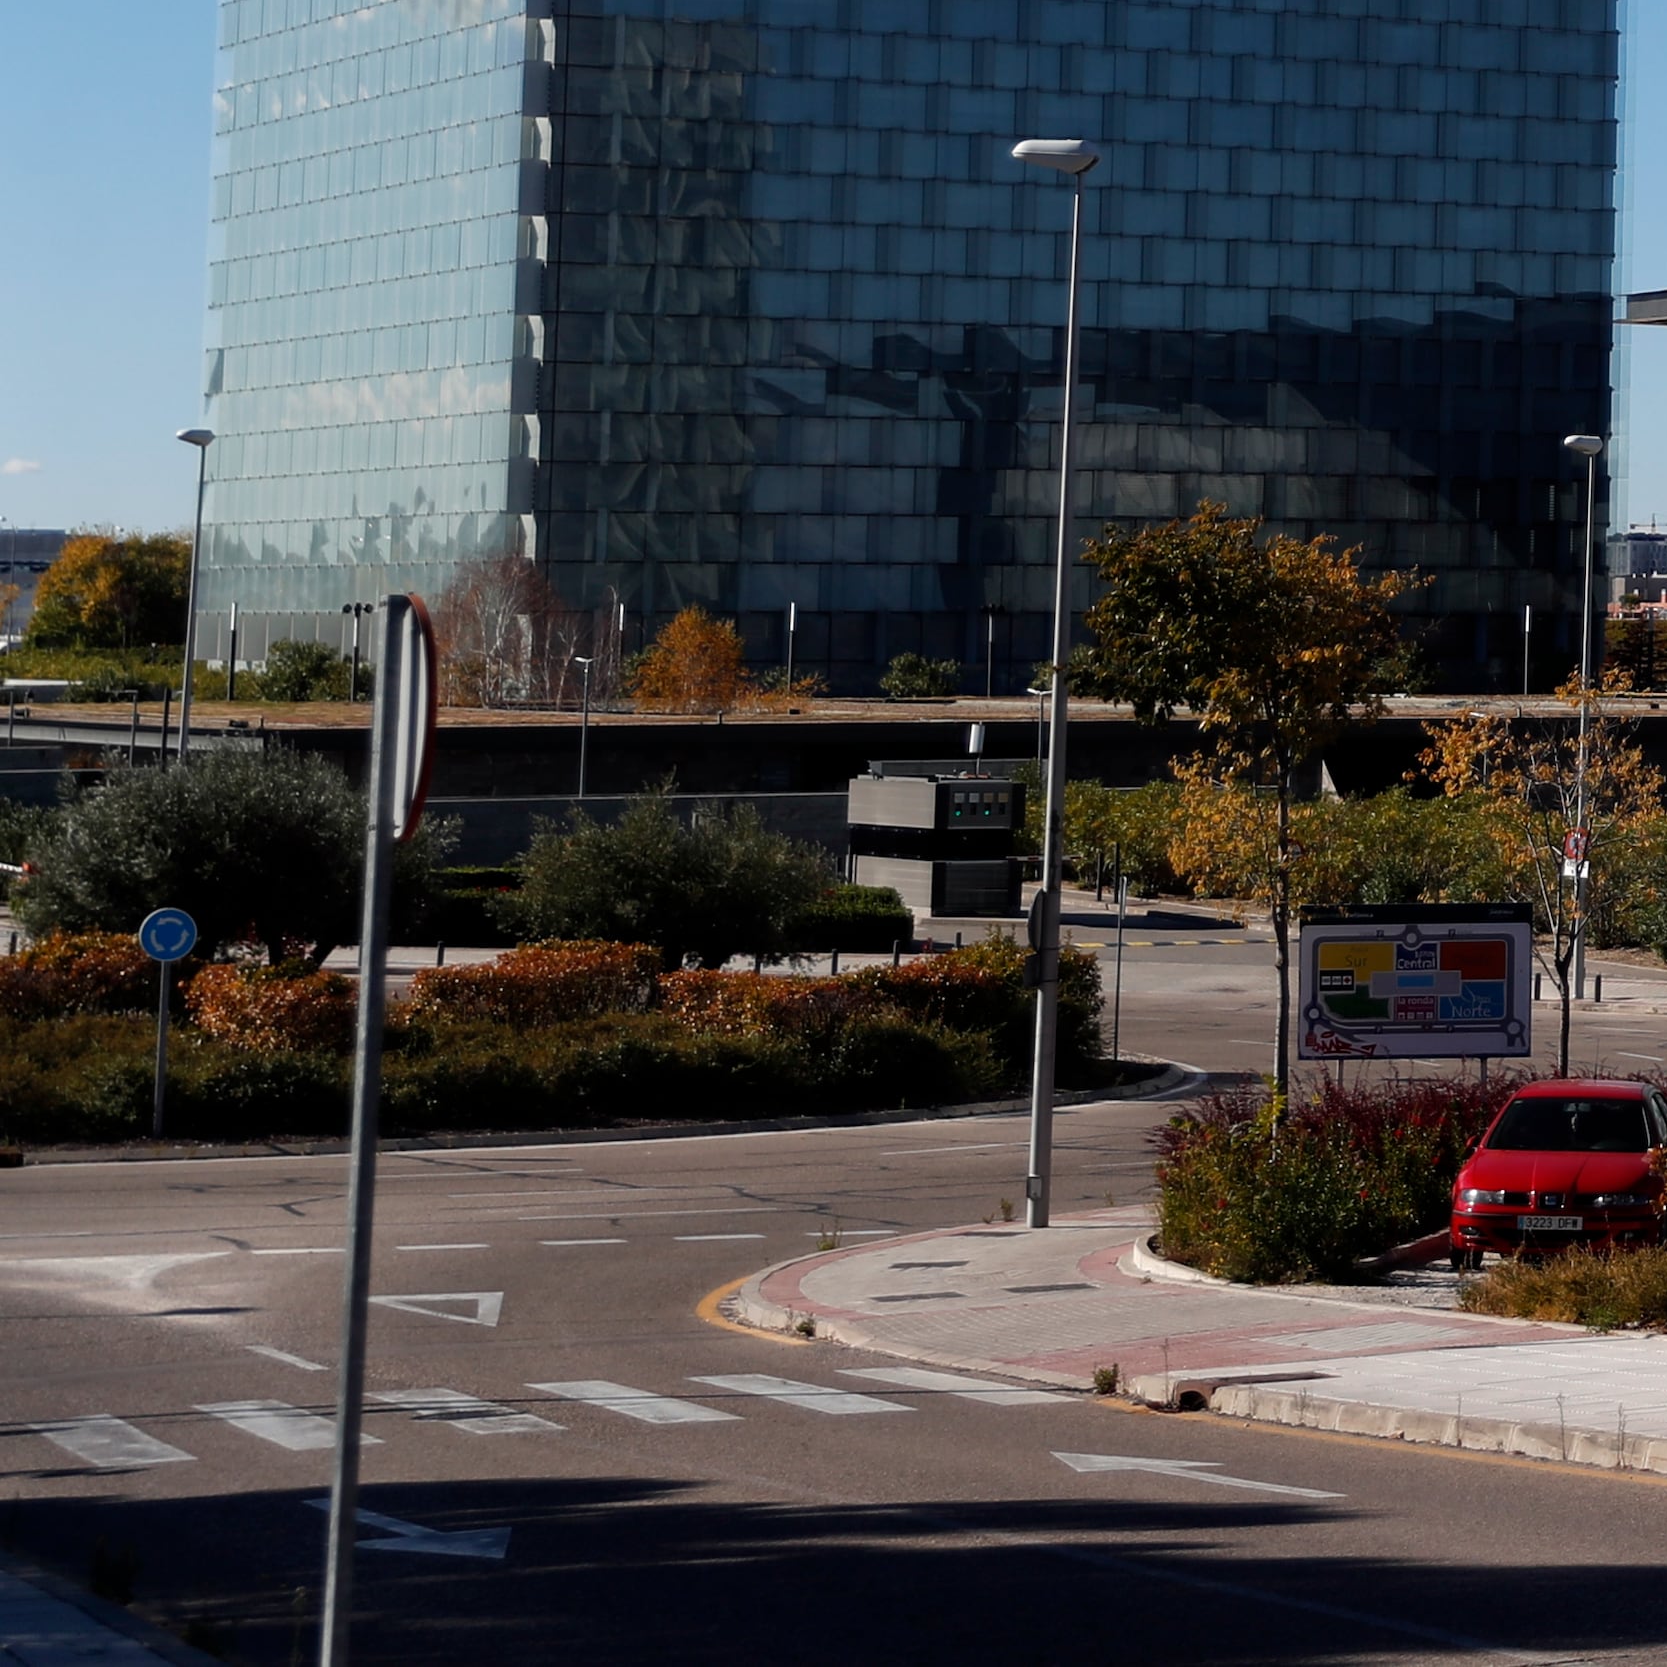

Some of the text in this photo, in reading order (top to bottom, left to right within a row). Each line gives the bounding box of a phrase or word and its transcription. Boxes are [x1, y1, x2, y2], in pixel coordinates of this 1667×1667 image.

[1345, 954, 1367, 967] Sur
[1397, 958, 1435, 970] Central
[1407, 996, 1434, 1005] ronda
[1451, 1004, 1491, 1018] Norte
[1526, 1217, 1552, 1228] 3223
